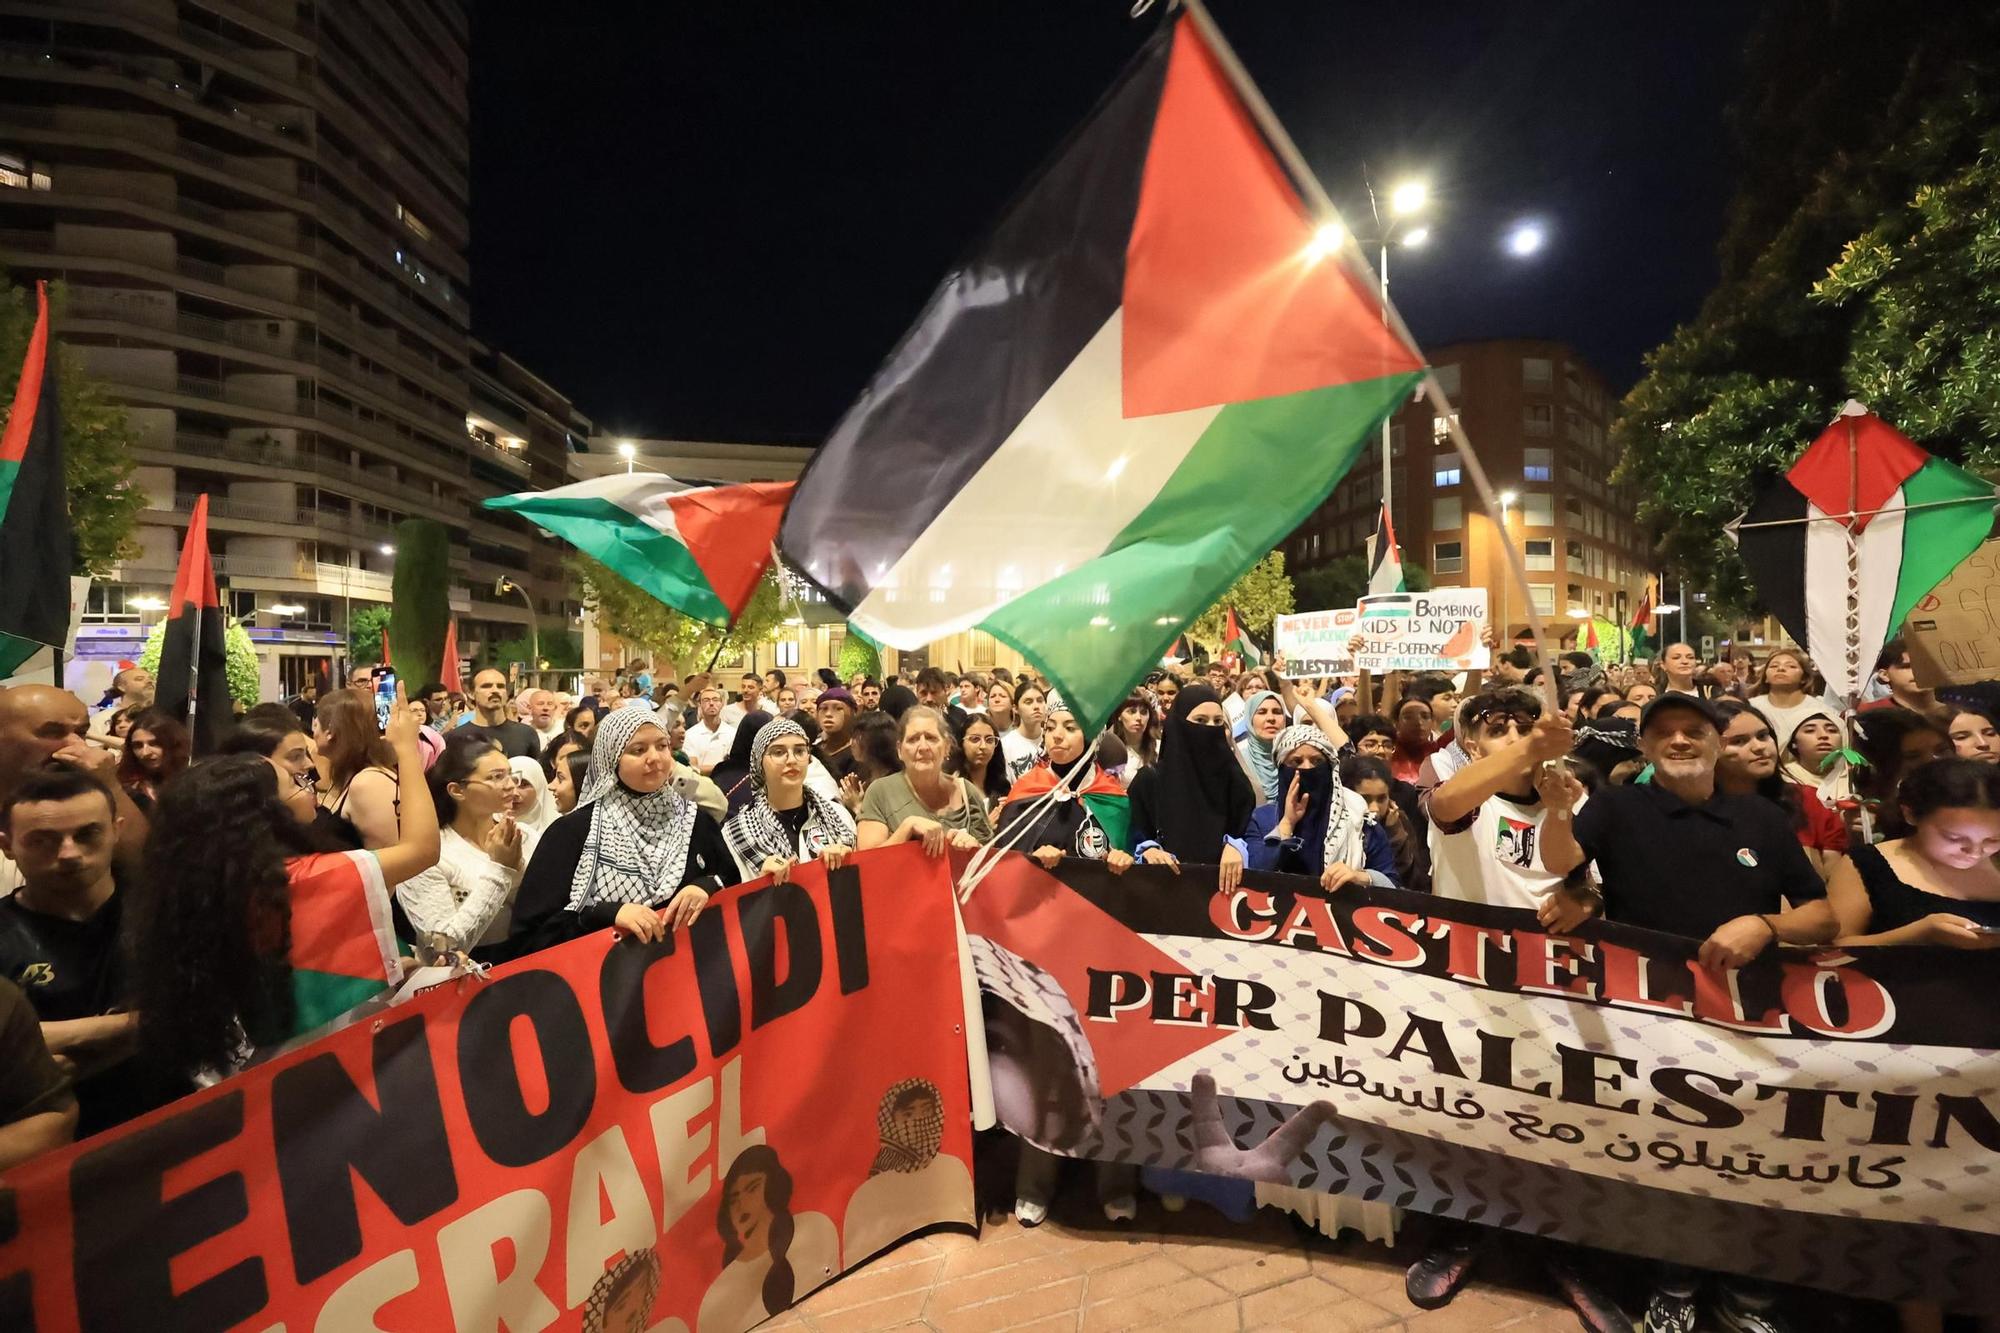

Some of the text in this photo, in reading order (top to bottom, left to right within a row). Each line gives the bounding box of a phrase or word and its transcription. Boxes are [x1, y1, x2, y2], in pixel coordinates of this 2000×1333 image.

[1361, 619, 1467, 634] KIDS IS NOT
[1361, 641, 1450, 654] SELF-DEFENSE
[1939, 638, 1998, 673] QUE
[1359, 657, 1454, 668] FREE PALESTINE
[1208, 886, 1897, 1039] CASTELLÓ
[1085, 967, 1285, 1032] PER
[0, 863, 870, 1333] ENOCIDI
[1282, 1055, 1907, 1189] كاستيلون مع فلسطين
[247, 1054, 766, 1333] SRAEL
